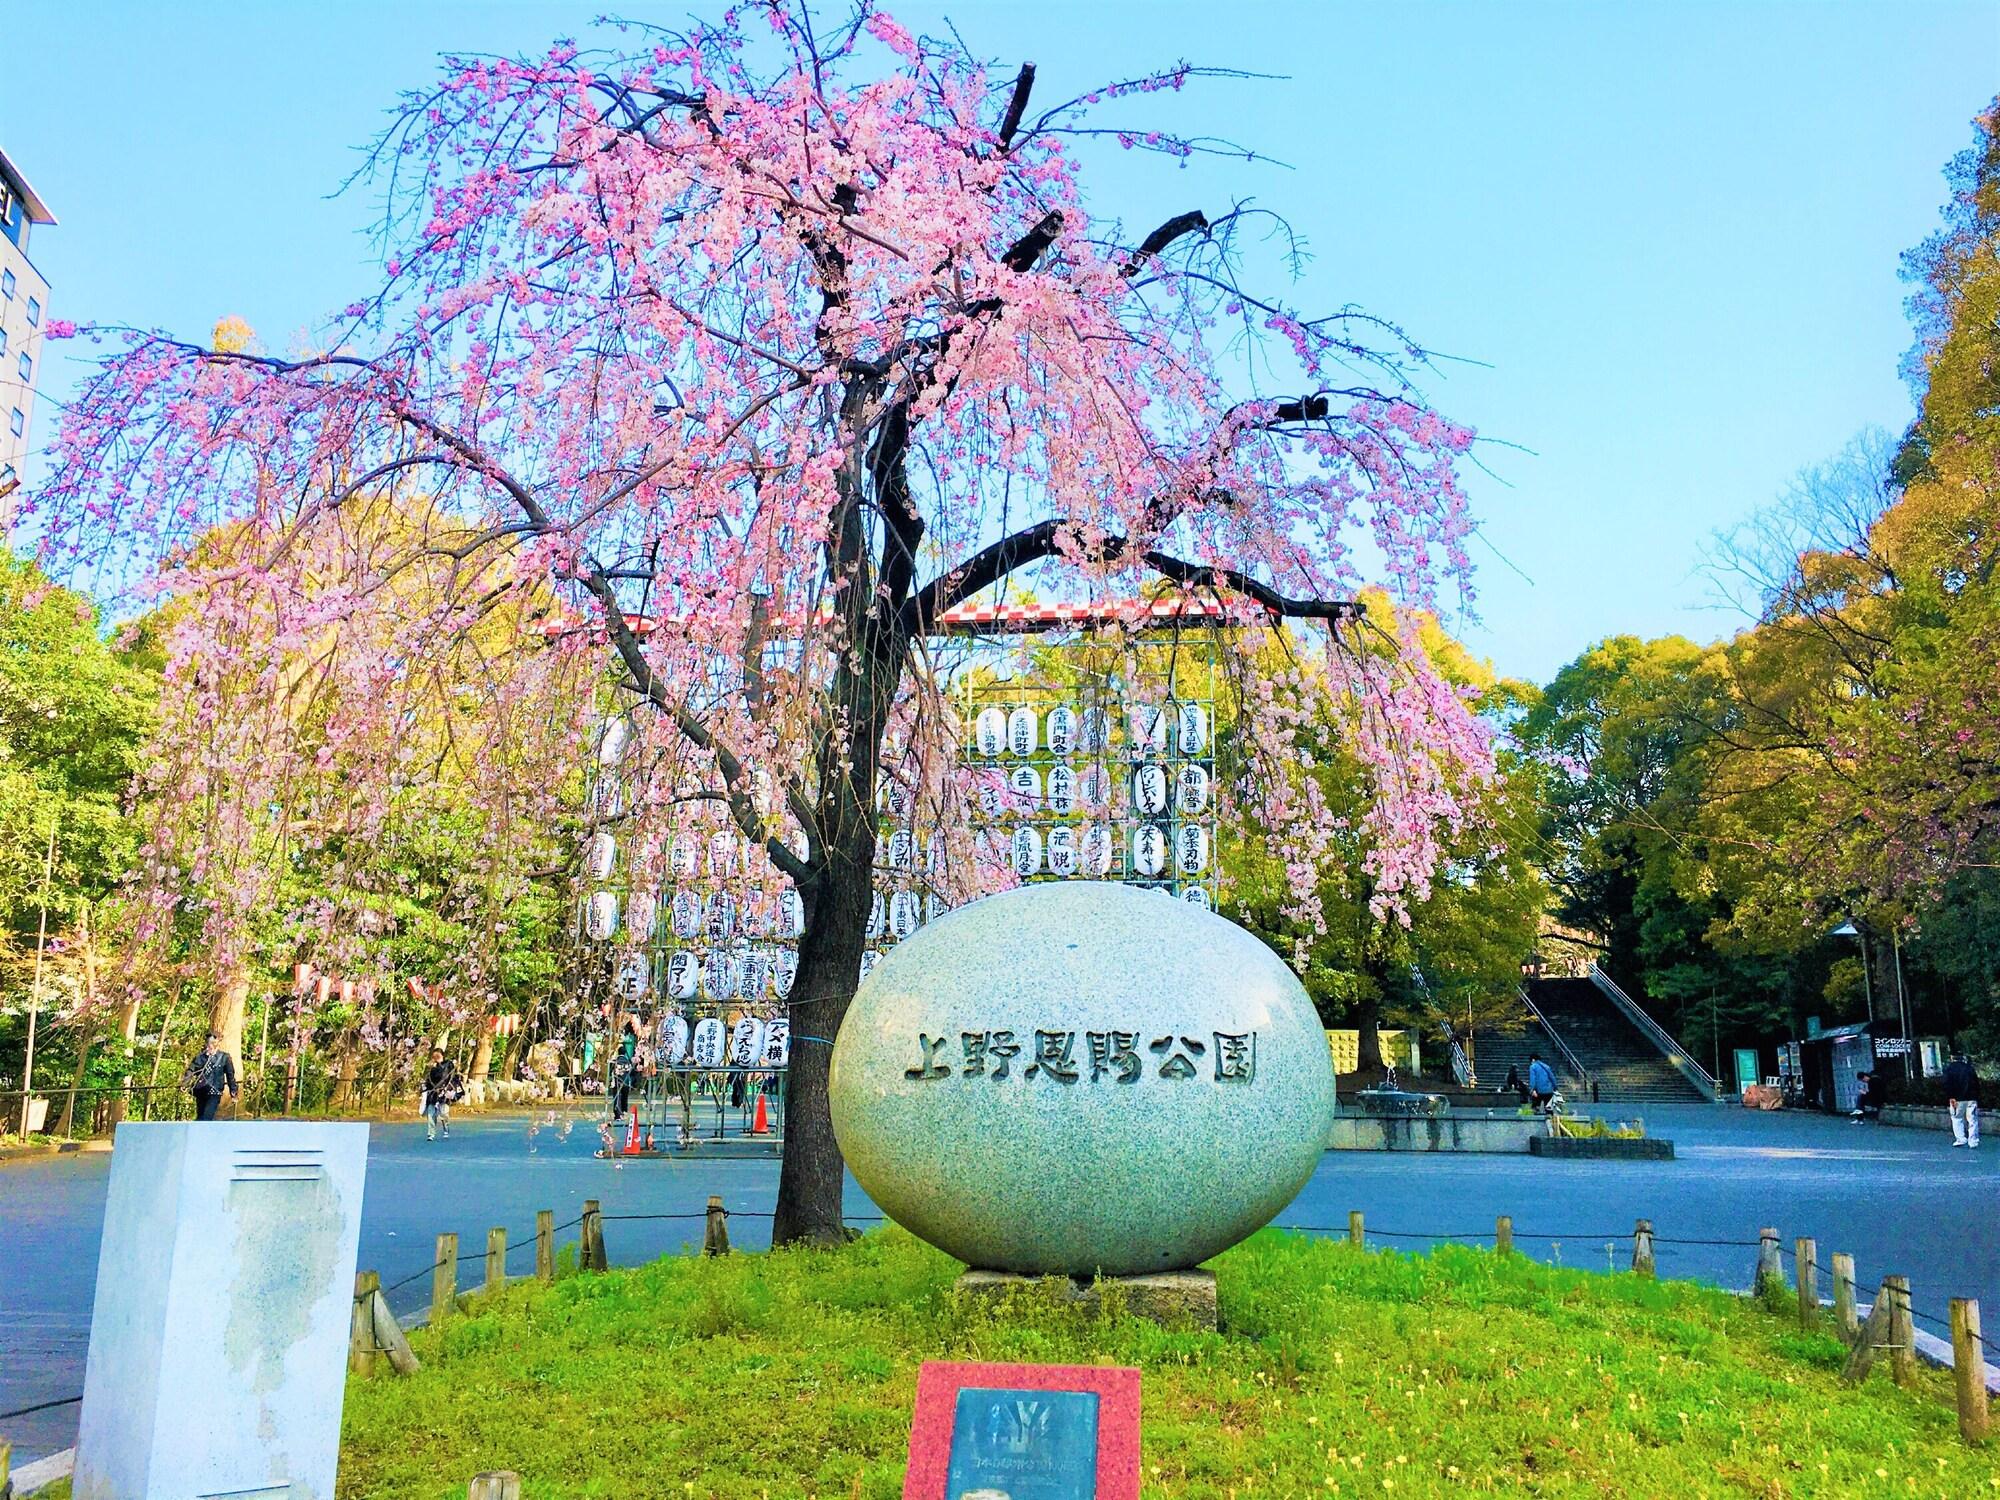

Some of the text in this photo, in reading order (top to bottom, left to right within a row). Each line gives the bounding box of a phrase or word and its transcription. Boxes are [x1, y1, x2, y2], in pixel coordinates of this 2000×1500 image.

[904, 1029, 1258, 1086] 上野恩賜公園
